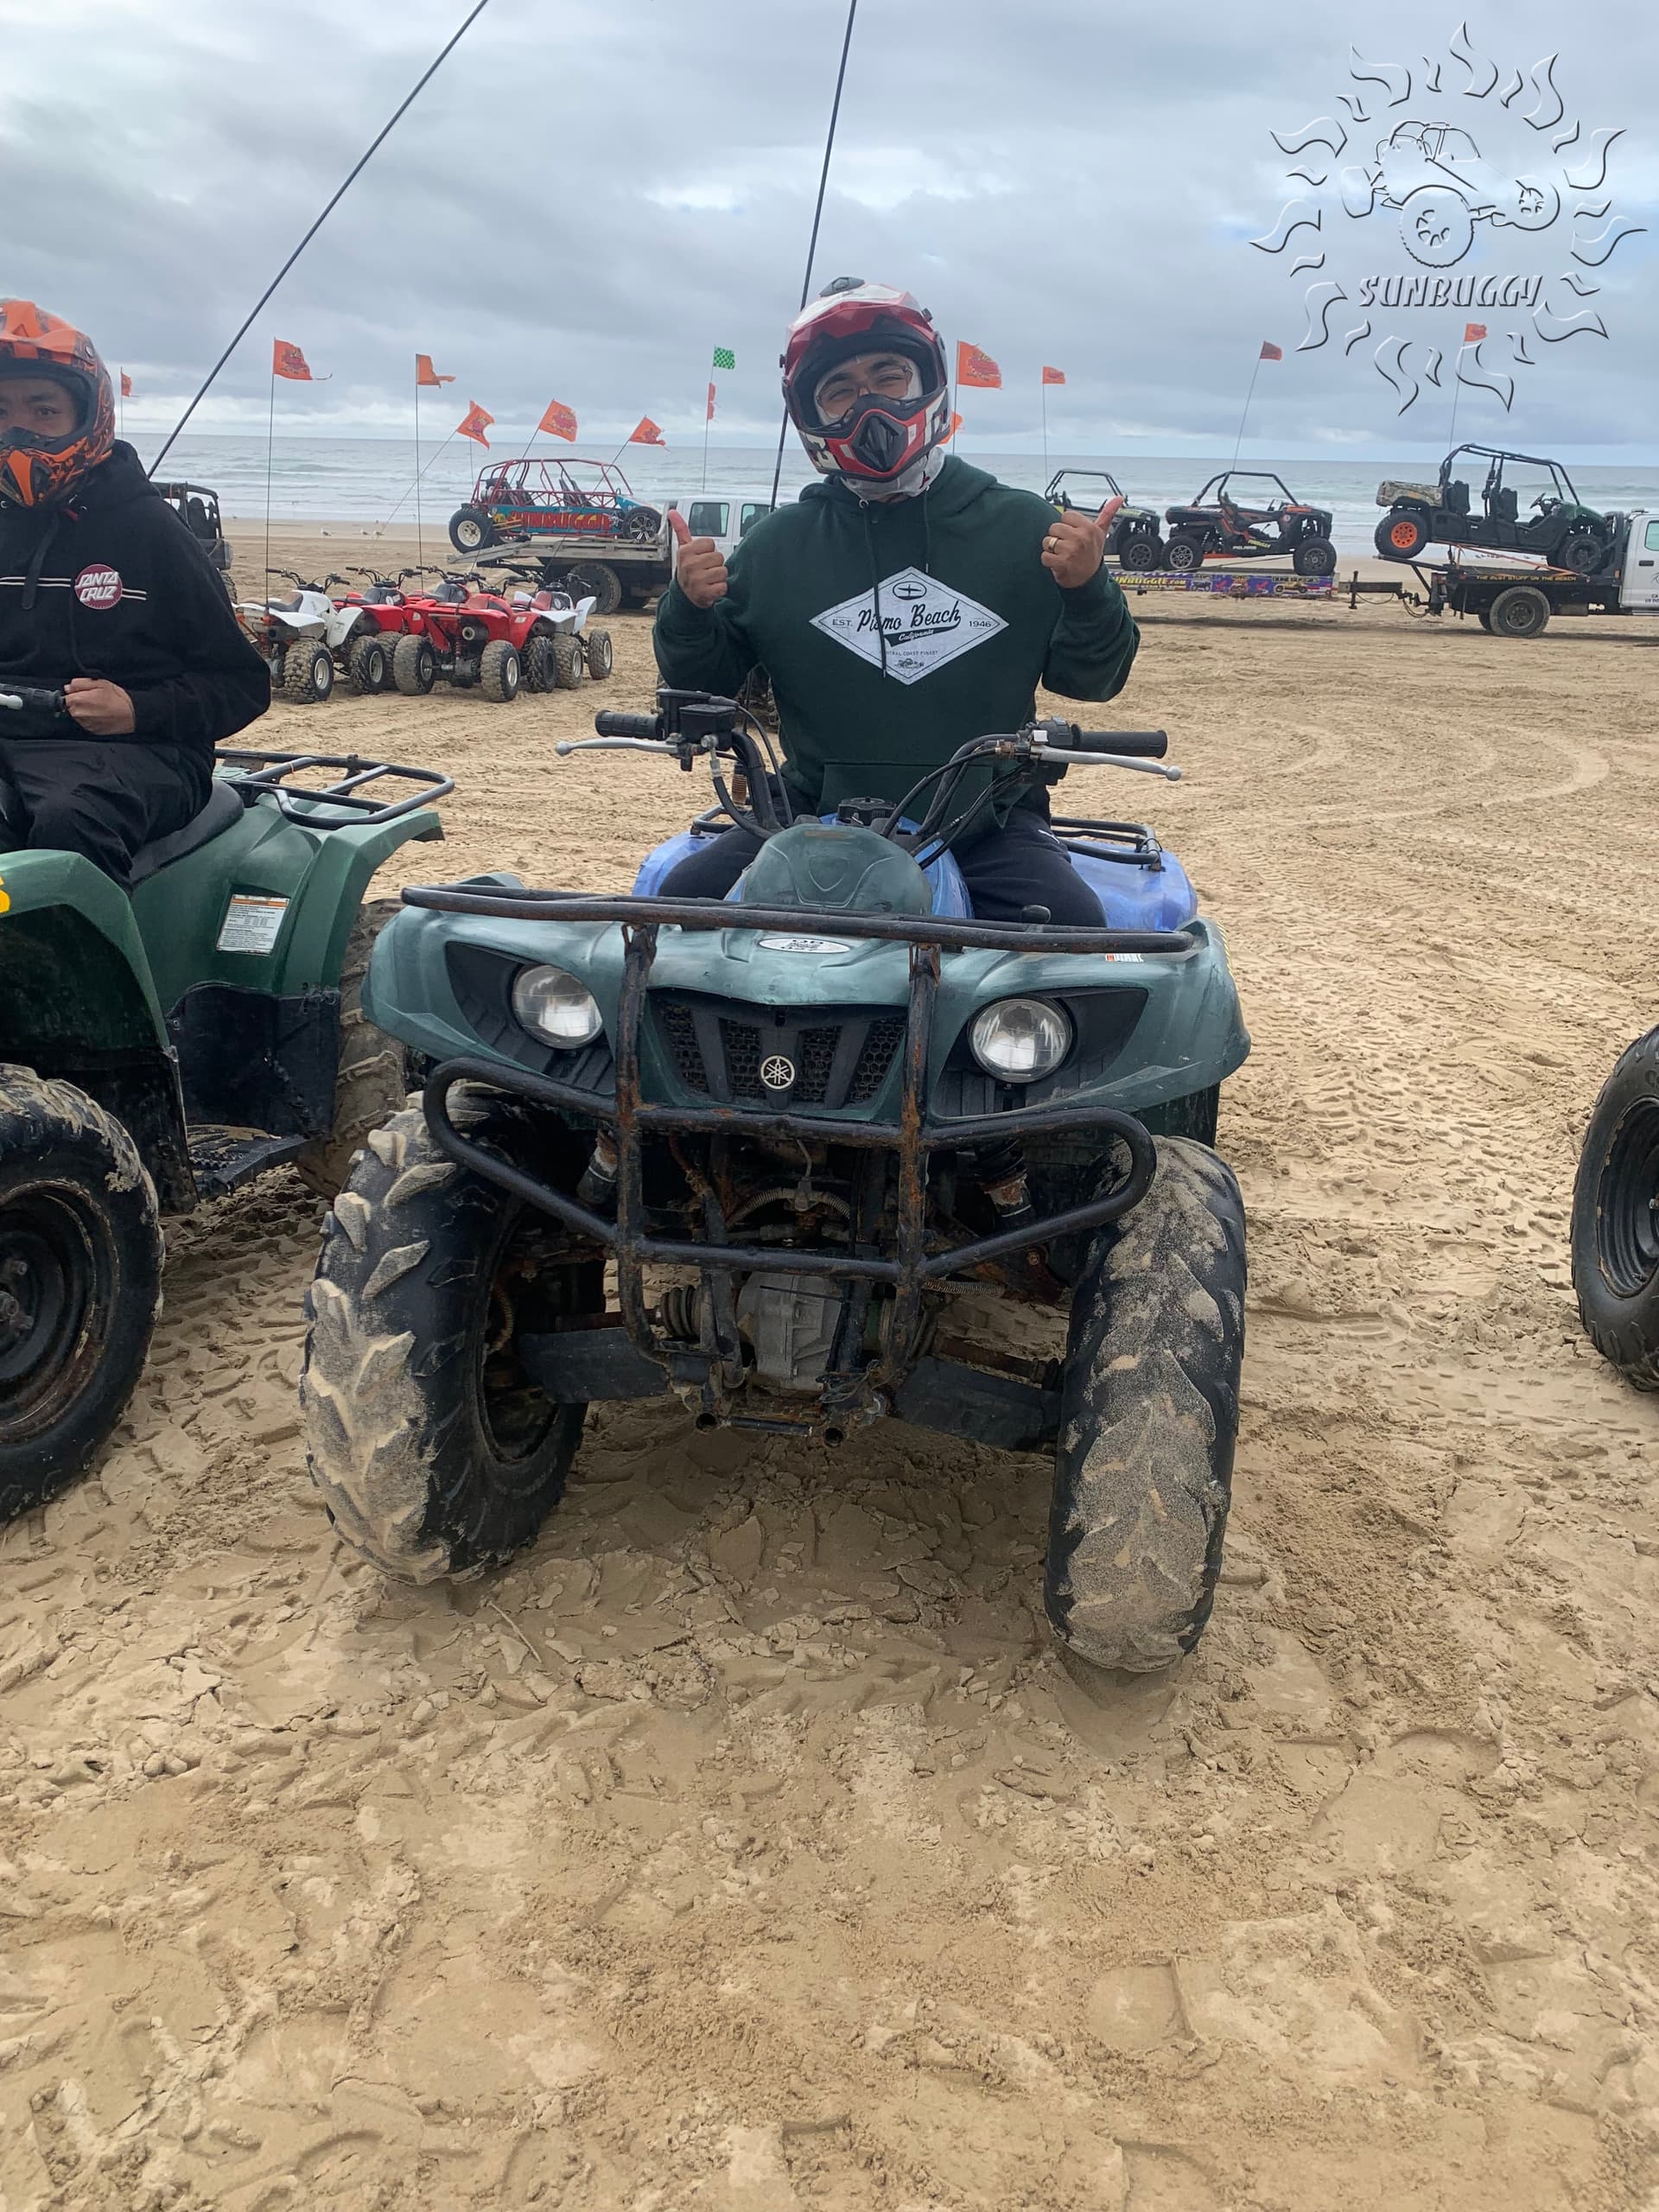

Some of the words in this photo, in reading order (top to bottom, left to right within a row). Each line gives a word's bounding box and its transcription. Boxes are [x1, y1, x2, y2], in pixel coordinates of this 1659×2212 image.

[74, 571, 118, 588] SANTA
[79, 586, 118, 602] CRUZ
[831, 618, 854, 627] EST.
[911, 601, 962, 630] Beach
[898, 629, 934, 642] California
